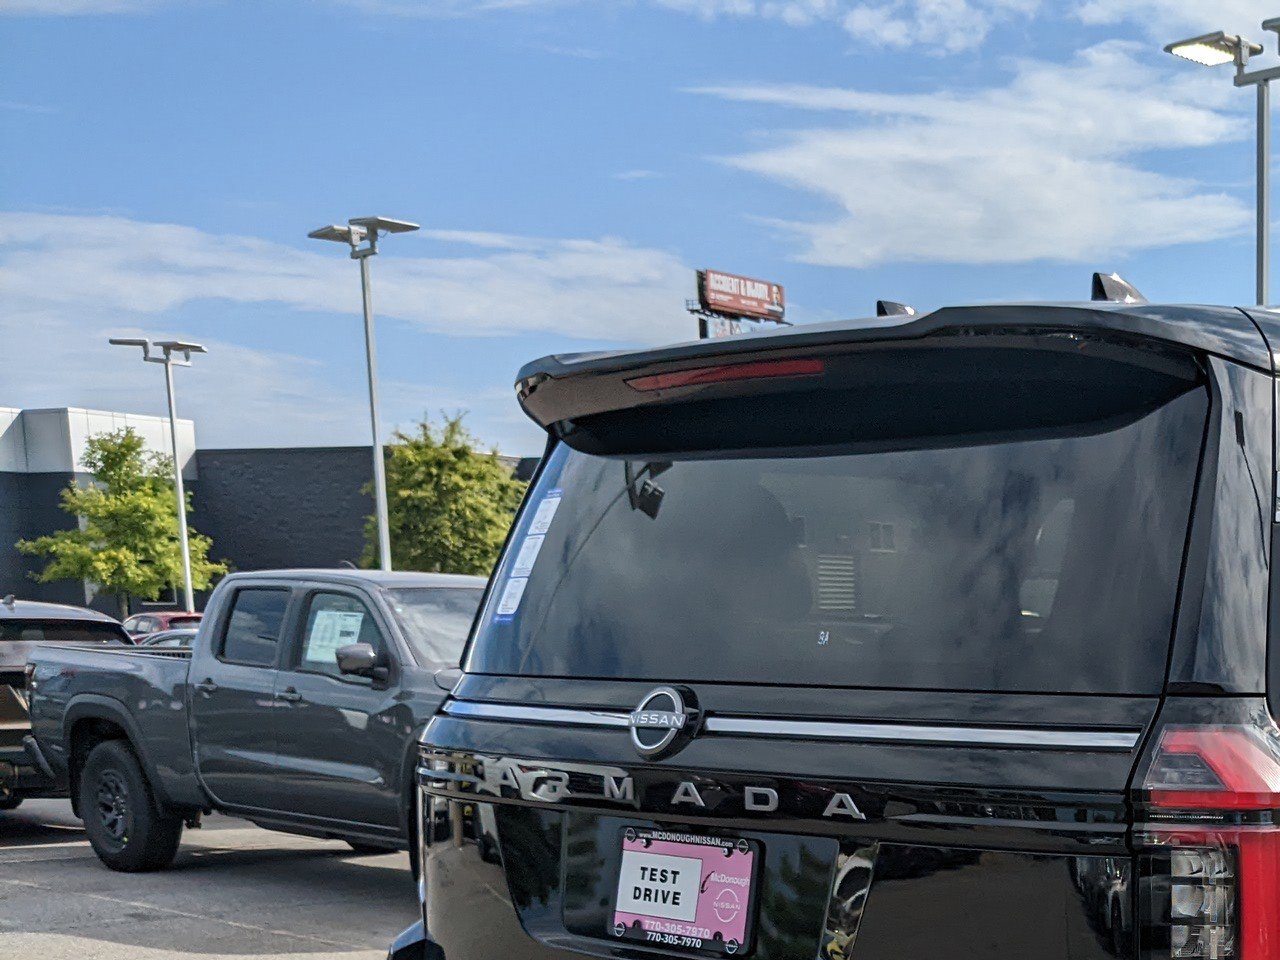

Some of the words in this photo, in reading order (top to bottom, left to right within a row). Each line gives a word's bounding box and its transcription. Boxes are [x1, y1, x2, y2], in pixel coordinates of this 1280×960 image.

[630, 713, 684, 727] NISSAN
[489, 762, 868, 820] ARMADA
[640, 866, 681, 885] TEST
[710, 872, 751, 887] McDonough
[632, 886, 682, 906] DRIVE
[644, 919, 711, 940] 770-305-7970
[646, 931, 702, 949] 770-305-7970
